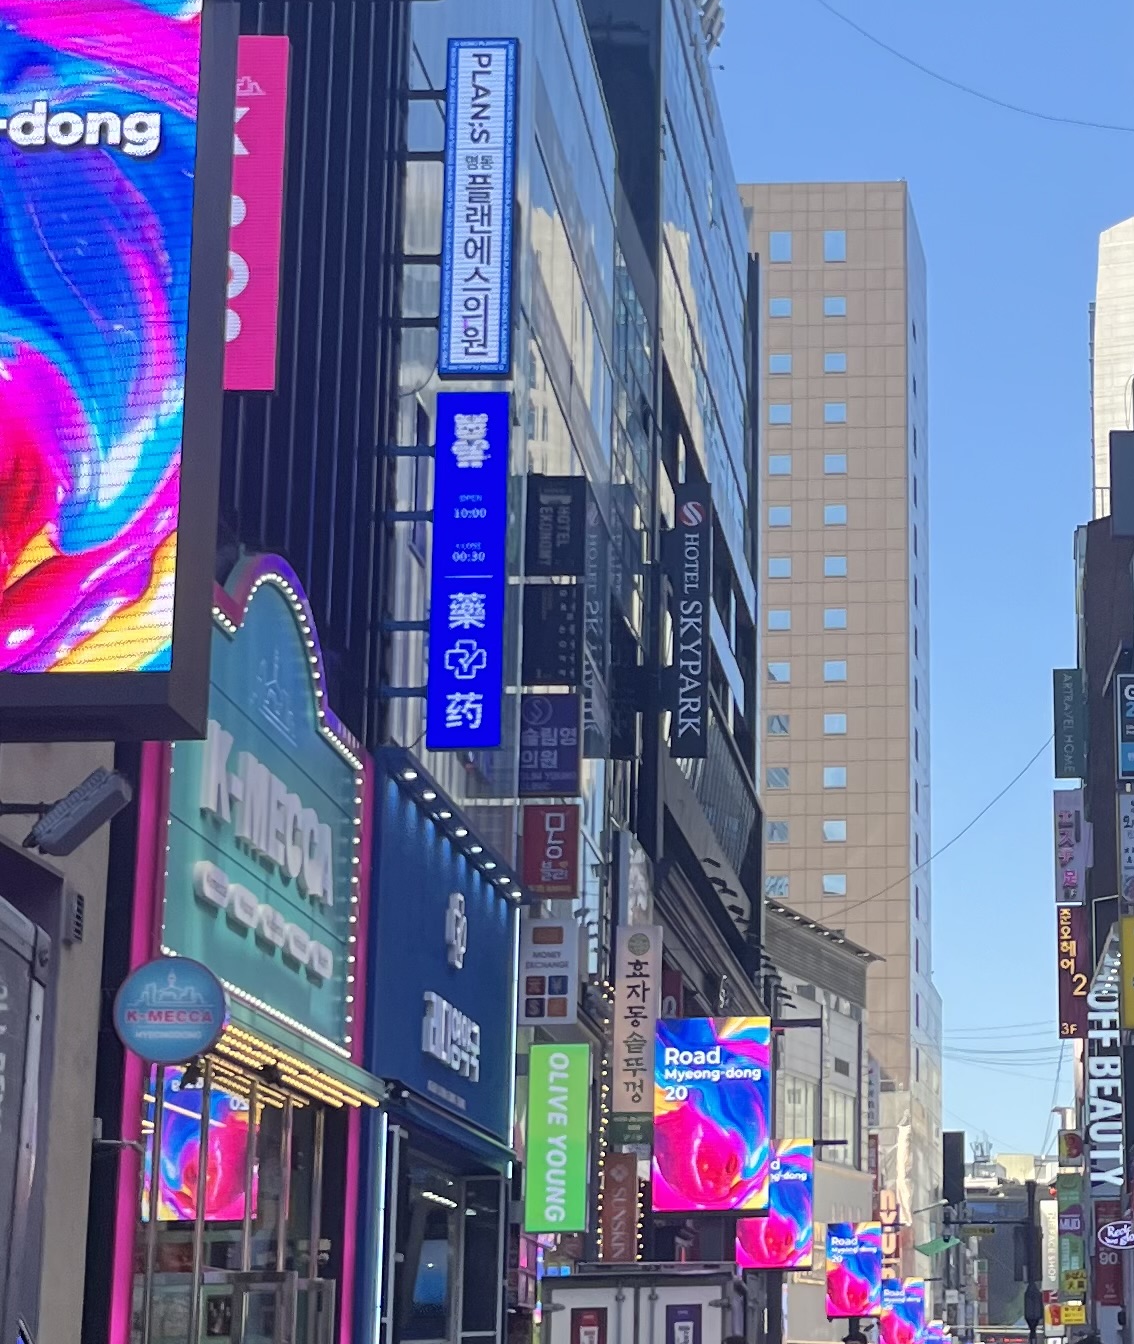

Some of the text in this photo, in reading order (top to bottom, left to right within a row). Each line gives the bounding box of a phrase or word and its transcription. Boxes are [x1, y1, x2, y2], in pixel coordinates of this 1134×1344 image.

[454, 507, 487, 519] 10:00
[556, 506, 570, 547] HOTEL
[452, 551, 486, 563] 00:30
[448, 593, 486, 629] 藥
[677, 533, 702, 737] HOTEL SKYPARK
[445, 693, 483, 730] 药
[1064, 734, 1075, 772] HOME
[200, 719, 334, 907] K-MECCA
[1060, 908, 1077, 975] 준오헤어
[1072, 974, 1087, 996] 2
[126, 1010, 213, 1023] K-MECCA
[1060, 1023, 1077, 1035] 3F
[664, 1047, 720, 1066] Road
[664, 1067, 762, 1083] Myeong-dong
[664, 1086, 688, 1101] 20
[1088, 1056, 1124, 1187] BEAUTY
[545, 1052, 569, 1222] OLIVE YOUNG
[831, 1236, 858, 1246] Road
